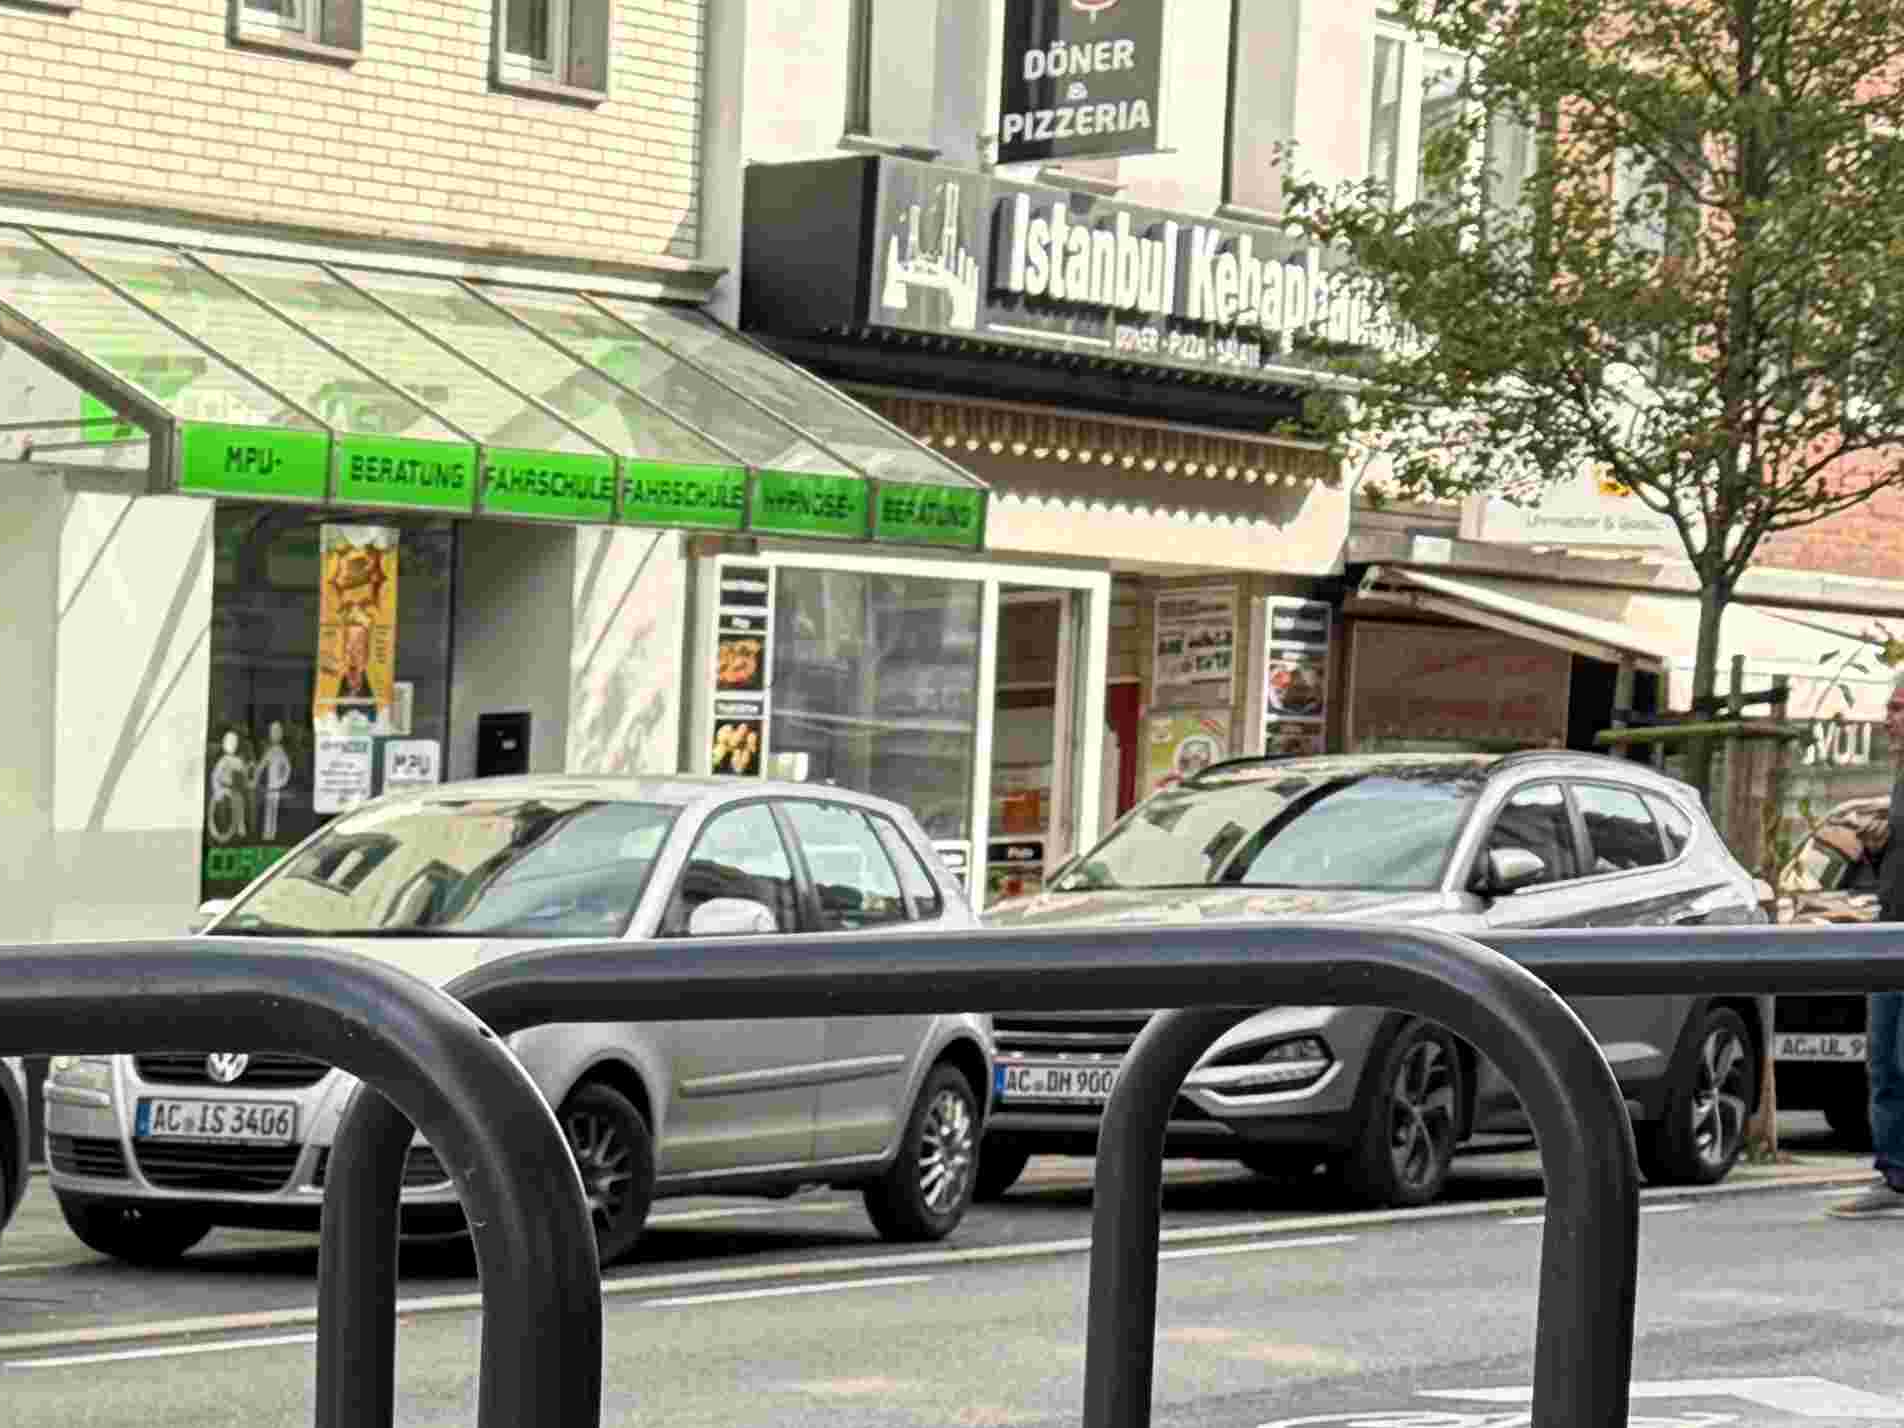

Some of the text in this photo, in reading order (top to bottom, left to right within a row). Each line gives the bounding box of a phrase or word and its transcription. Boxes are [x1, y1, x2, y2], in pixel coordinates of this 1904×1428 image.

[1023, 39, 1136, 80] DÖNER
[1002, 99, 1152, 143] PIZZERIA
[1009, 191, 1178, 317] Istanbul
[349, 454, 466, 489] BERATUNG
[486, 466, 614, 502] FAHRSCHULE
[623, 477, 745, 511] FAHRSCHULE
[1008, 1069, 1031, 1093] AC
[153, 1104, 290, 1136] AC IS 3406
